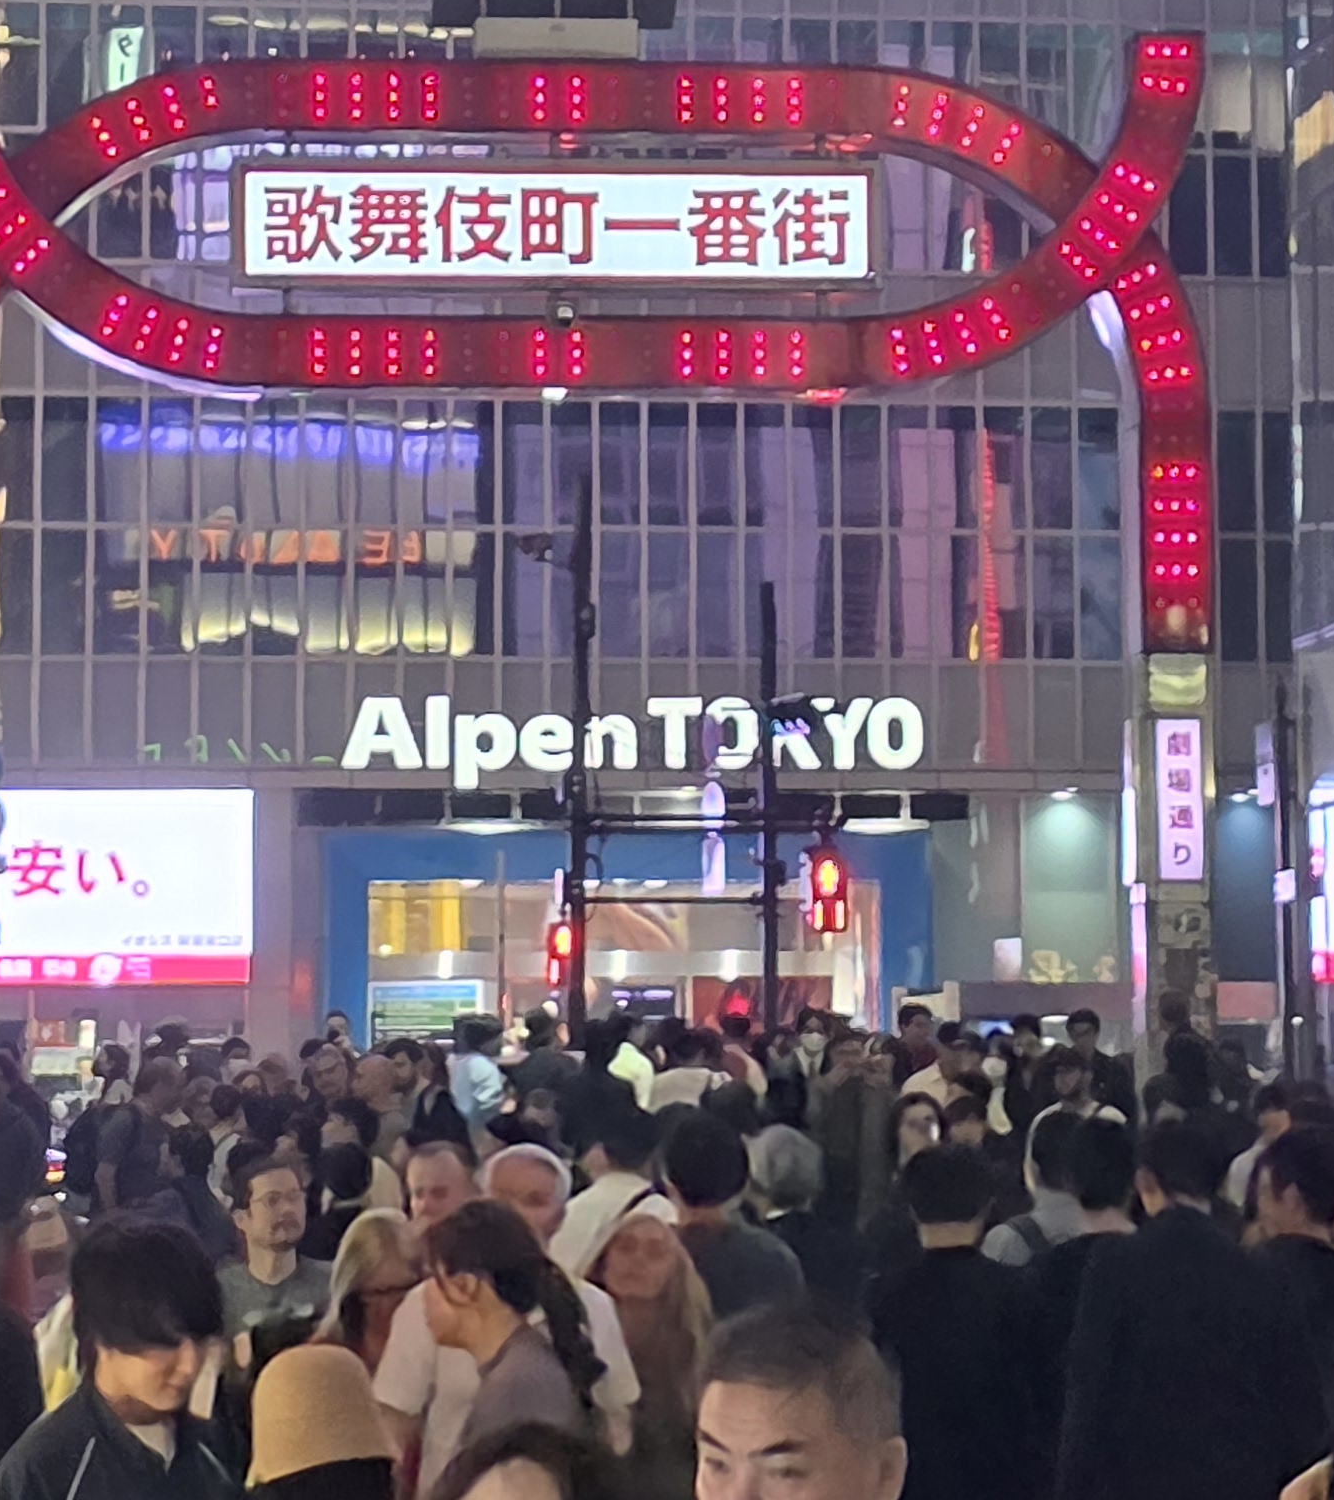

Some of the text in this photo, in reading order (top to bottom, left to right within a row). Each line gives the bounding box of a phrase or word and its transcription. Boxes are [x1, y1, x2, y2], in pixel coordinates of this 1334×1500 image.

[264, 184, 851, 266] 歌舞伎町一番街
[341, 695, 637, 791] Alpen
[7, 838, 150, 897] 安い。
